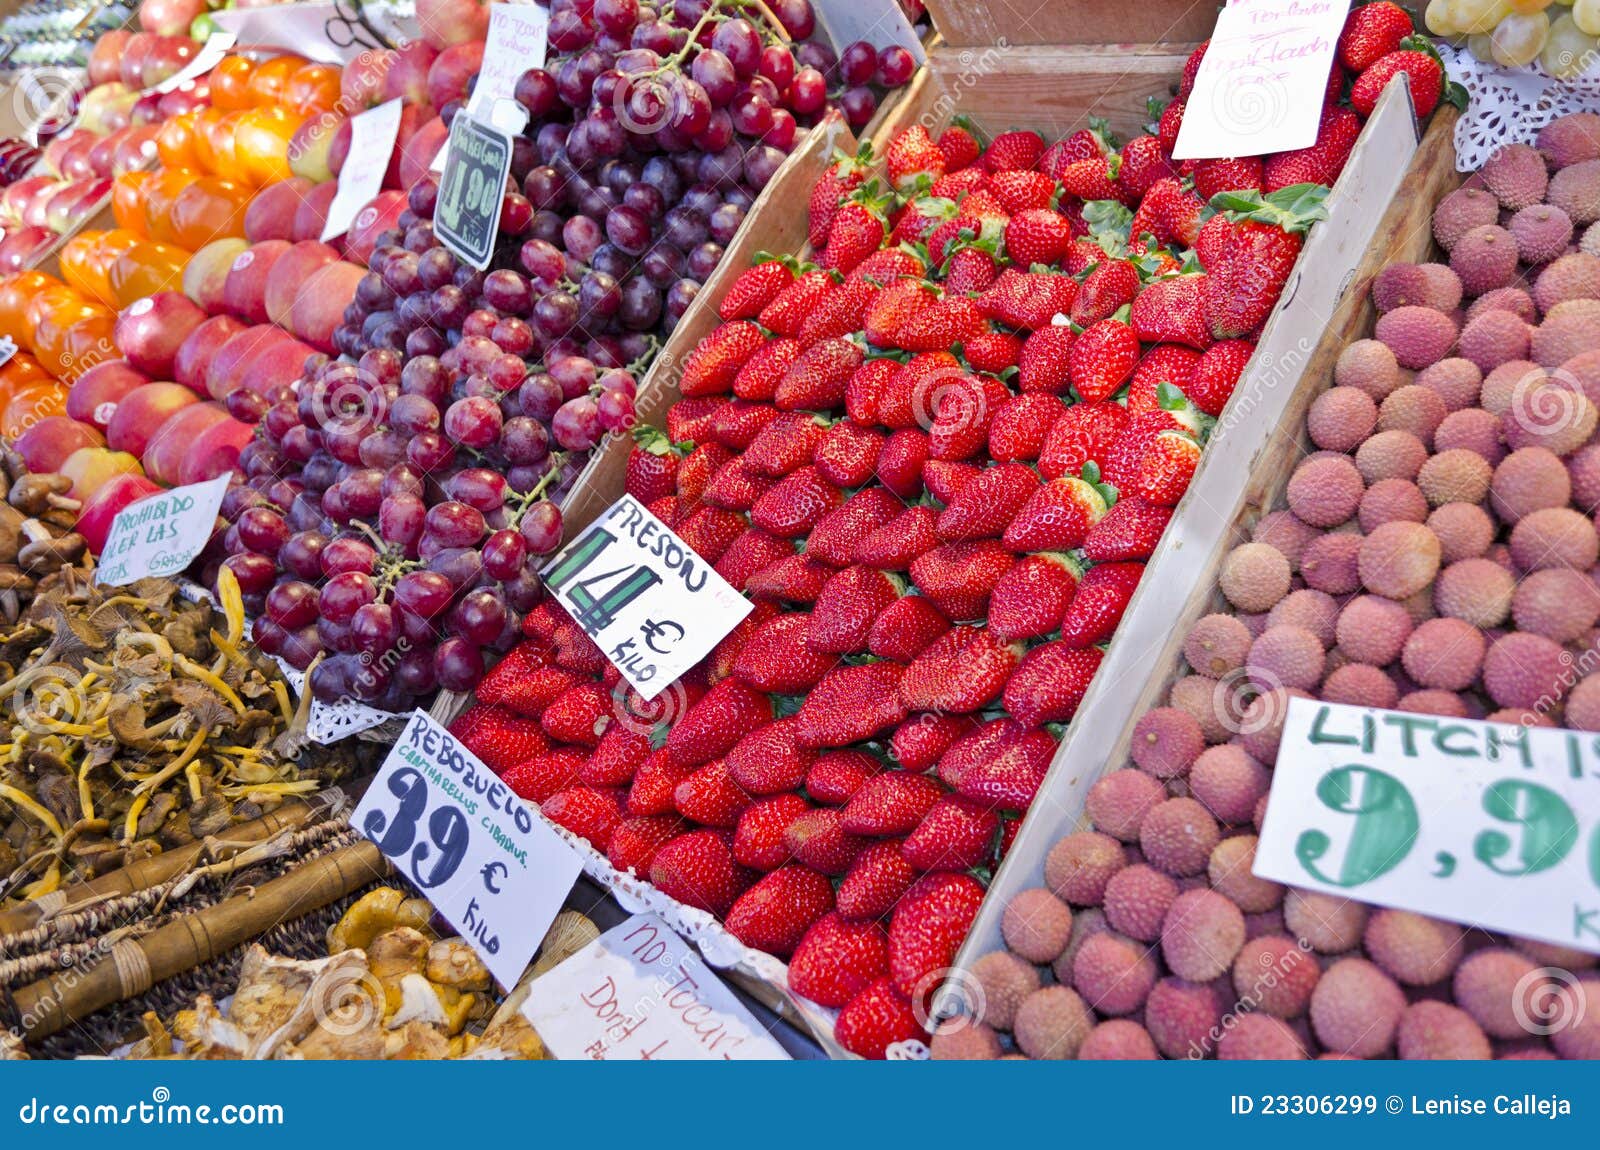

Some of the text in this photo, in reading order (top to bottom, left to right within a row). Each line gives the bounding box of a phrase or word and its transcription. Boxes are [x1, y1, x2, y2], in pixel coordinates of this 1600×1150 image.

[146, 518, 178, 544] LAS
[536, 526, 664, 637] 14
[608, 636, 658, 683] KILO
[362, 766, 470, 889] 39
[409, 714, 532, 835] REBOZUELO
[1294, 763, 1600, 890] 9,9
[462, 897, 501, 955] KILO
